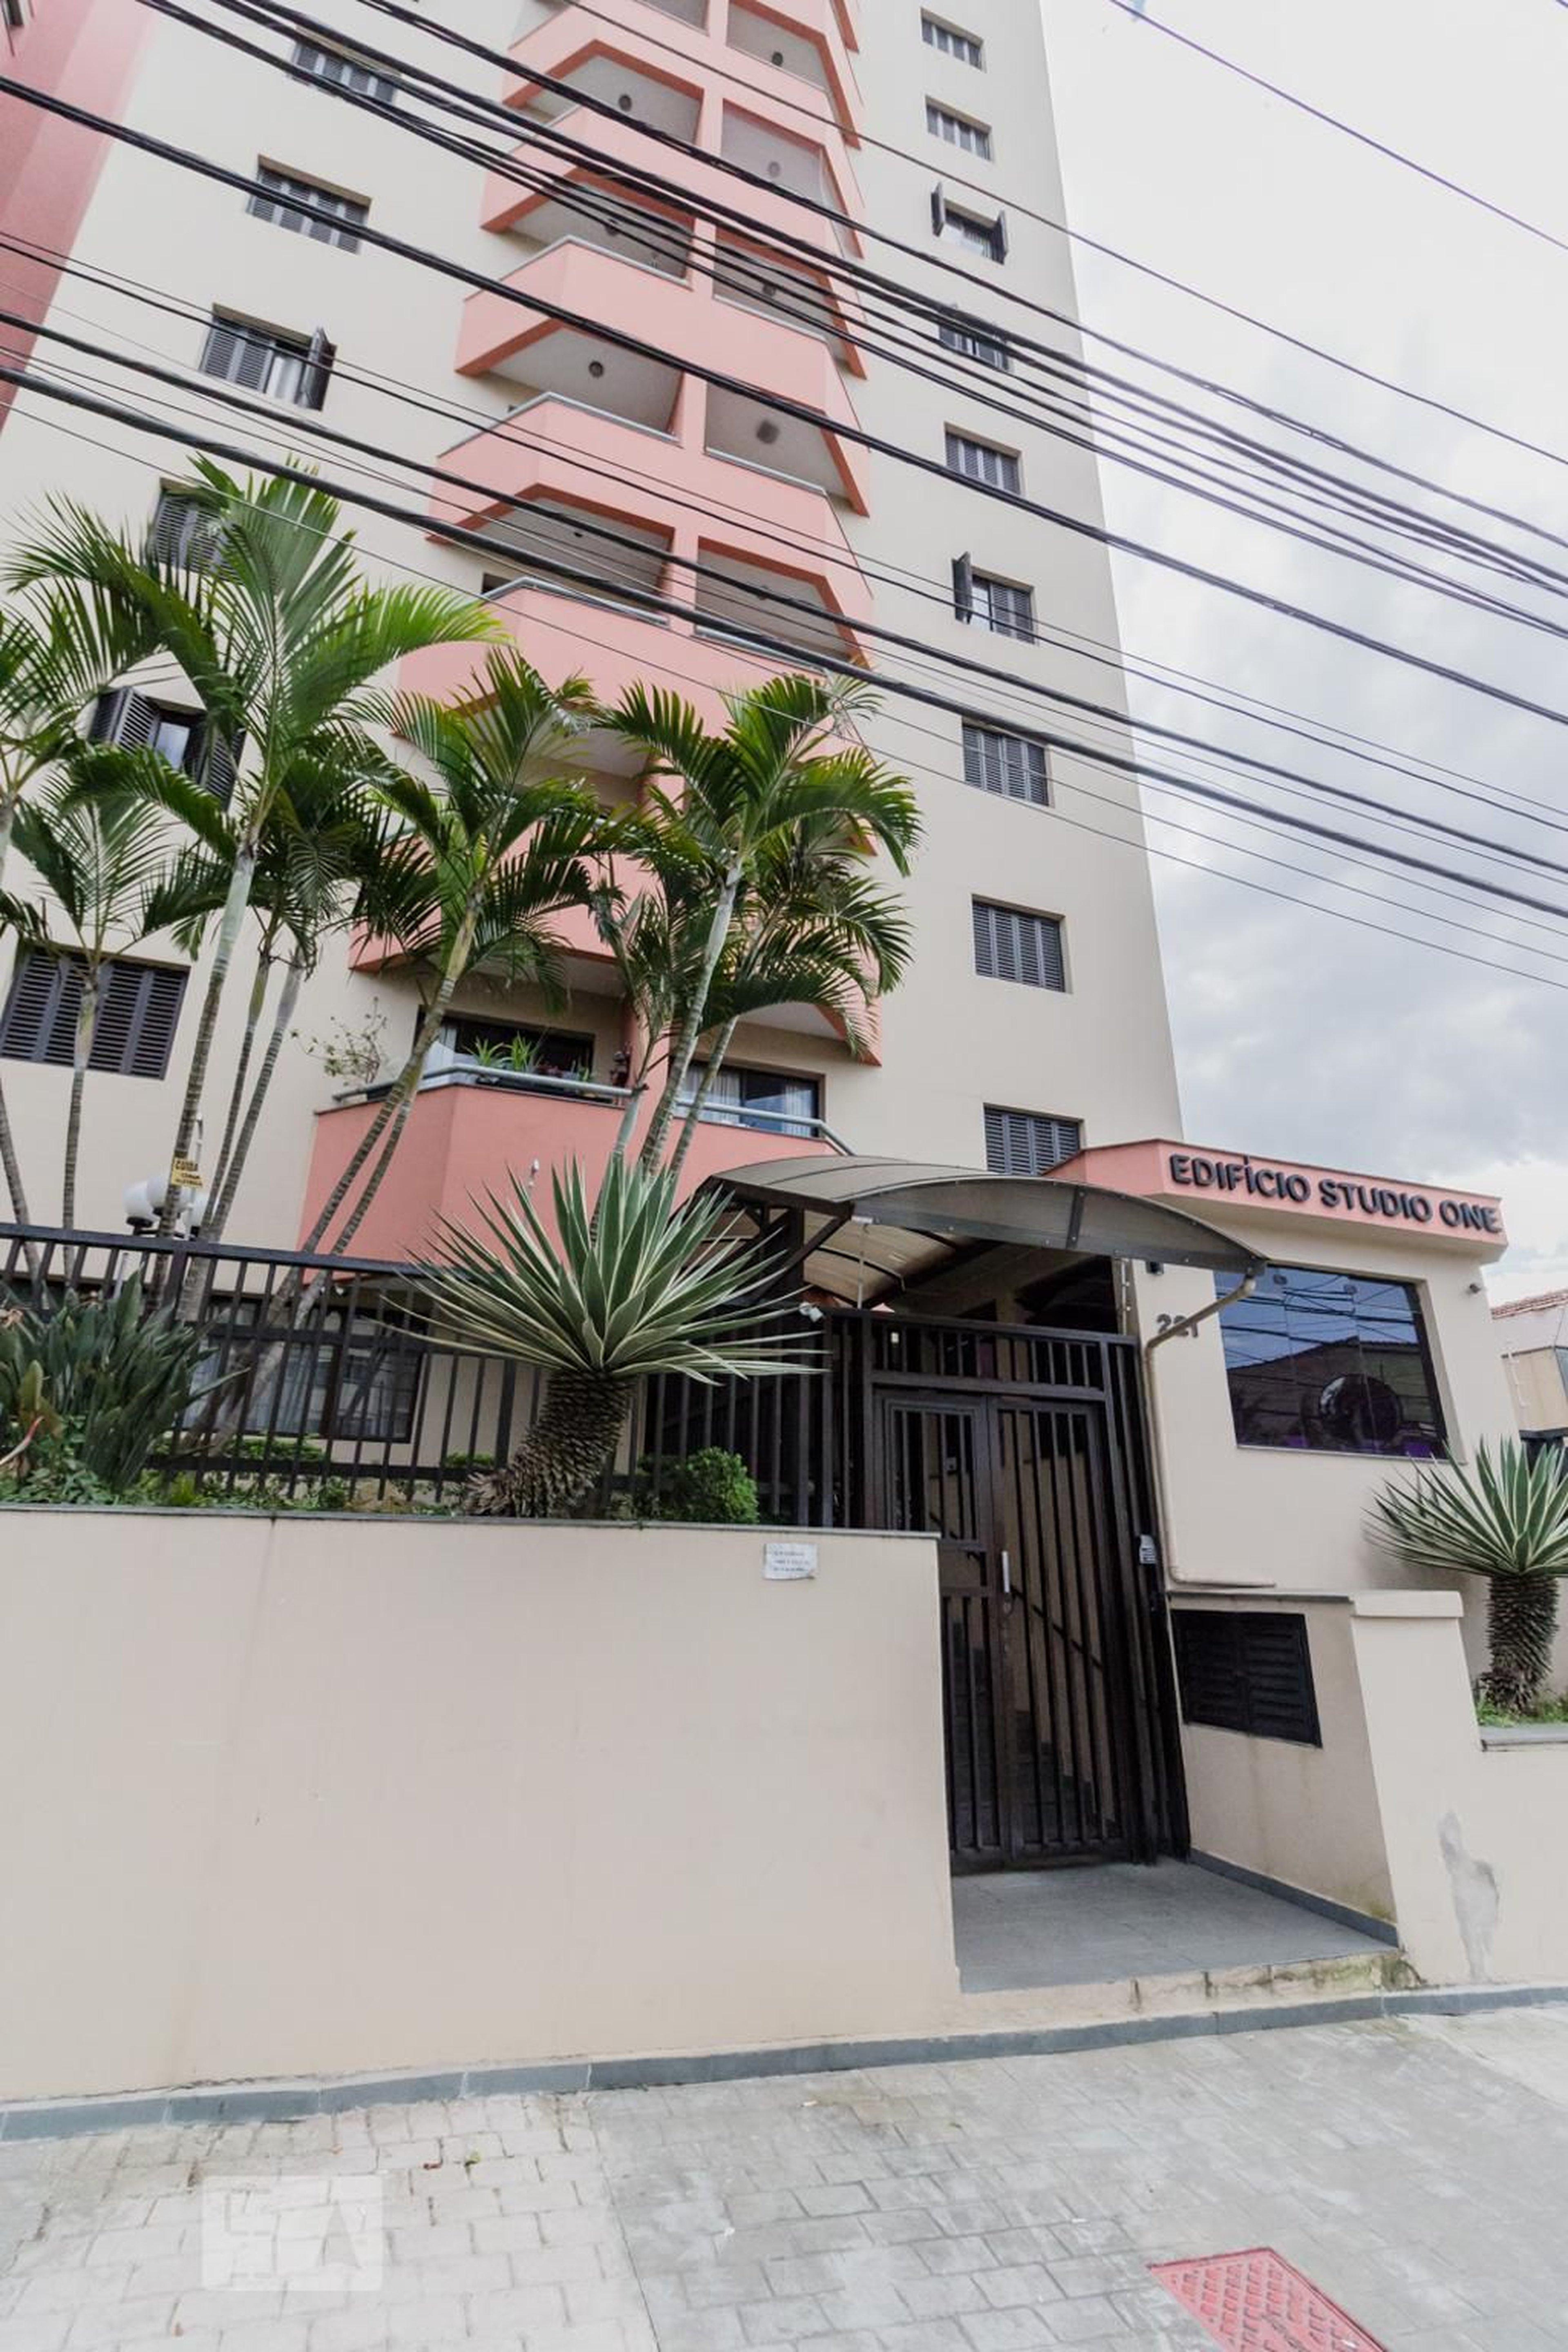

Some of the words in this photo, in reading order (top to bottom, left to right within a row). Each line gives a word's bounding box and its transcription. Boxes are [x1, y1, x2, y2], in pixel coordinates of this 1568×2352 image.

[1169, 1154, 1312, 1203] EDIFÍCIO
[1319, 1178, 1434, 1223] STUDIO
[1439, 1199, 1503, 1234] ONE
